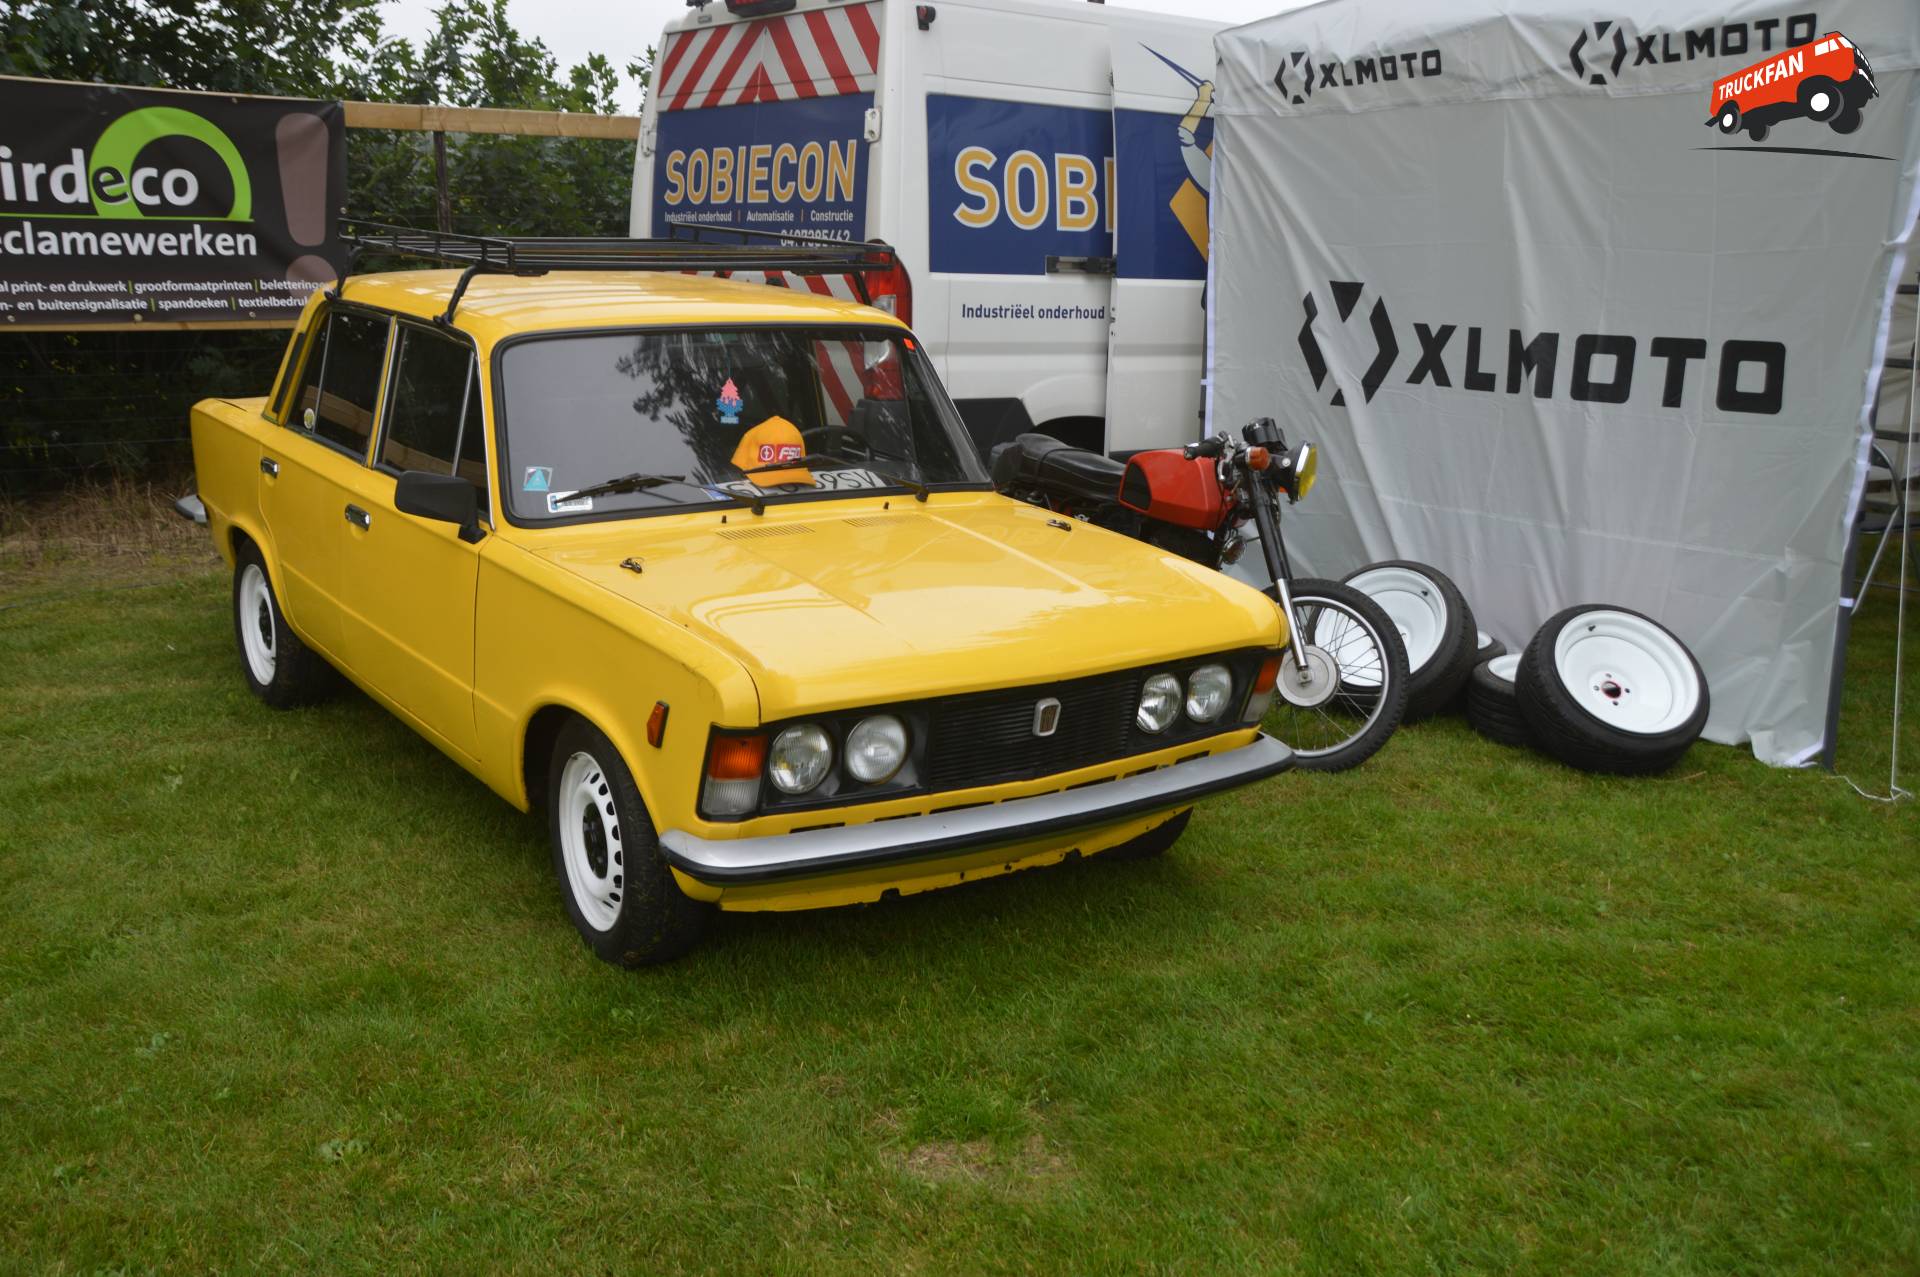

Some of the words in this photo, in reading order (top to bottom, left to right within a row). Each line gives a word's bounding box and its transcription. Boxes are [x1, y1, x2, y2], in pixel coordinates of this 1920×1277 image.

[1633, 13, 1817, 66] XLMOTO
[1319, 49, 1442, 88] XLMOTO
[664, 139, 857, 206] SOBIECON
[698, 210, 732, 222] onderhoud
[746, 209, 795, 222] Automatisatie
[810, 209, 854, 222] Constructie
[0, 221, 257, 257] clamewerken
[11, 281, 47, 295] print-
[50, 284, 66, 292] en
[68, 281, 127, 293] drukwerk
[134, 279, 253, 295] grootformaatprinten
[17, 302, 35, 311] en
[38, 298, 148, 313] buitensignalisatie
[158, 296, 229, 311] spandoeken
[962, 303, 1035, 320] Industriëel
[1038, 305, 1105, 320] onderhoud
[1405, 322, 1787, 415] XLMOTO
